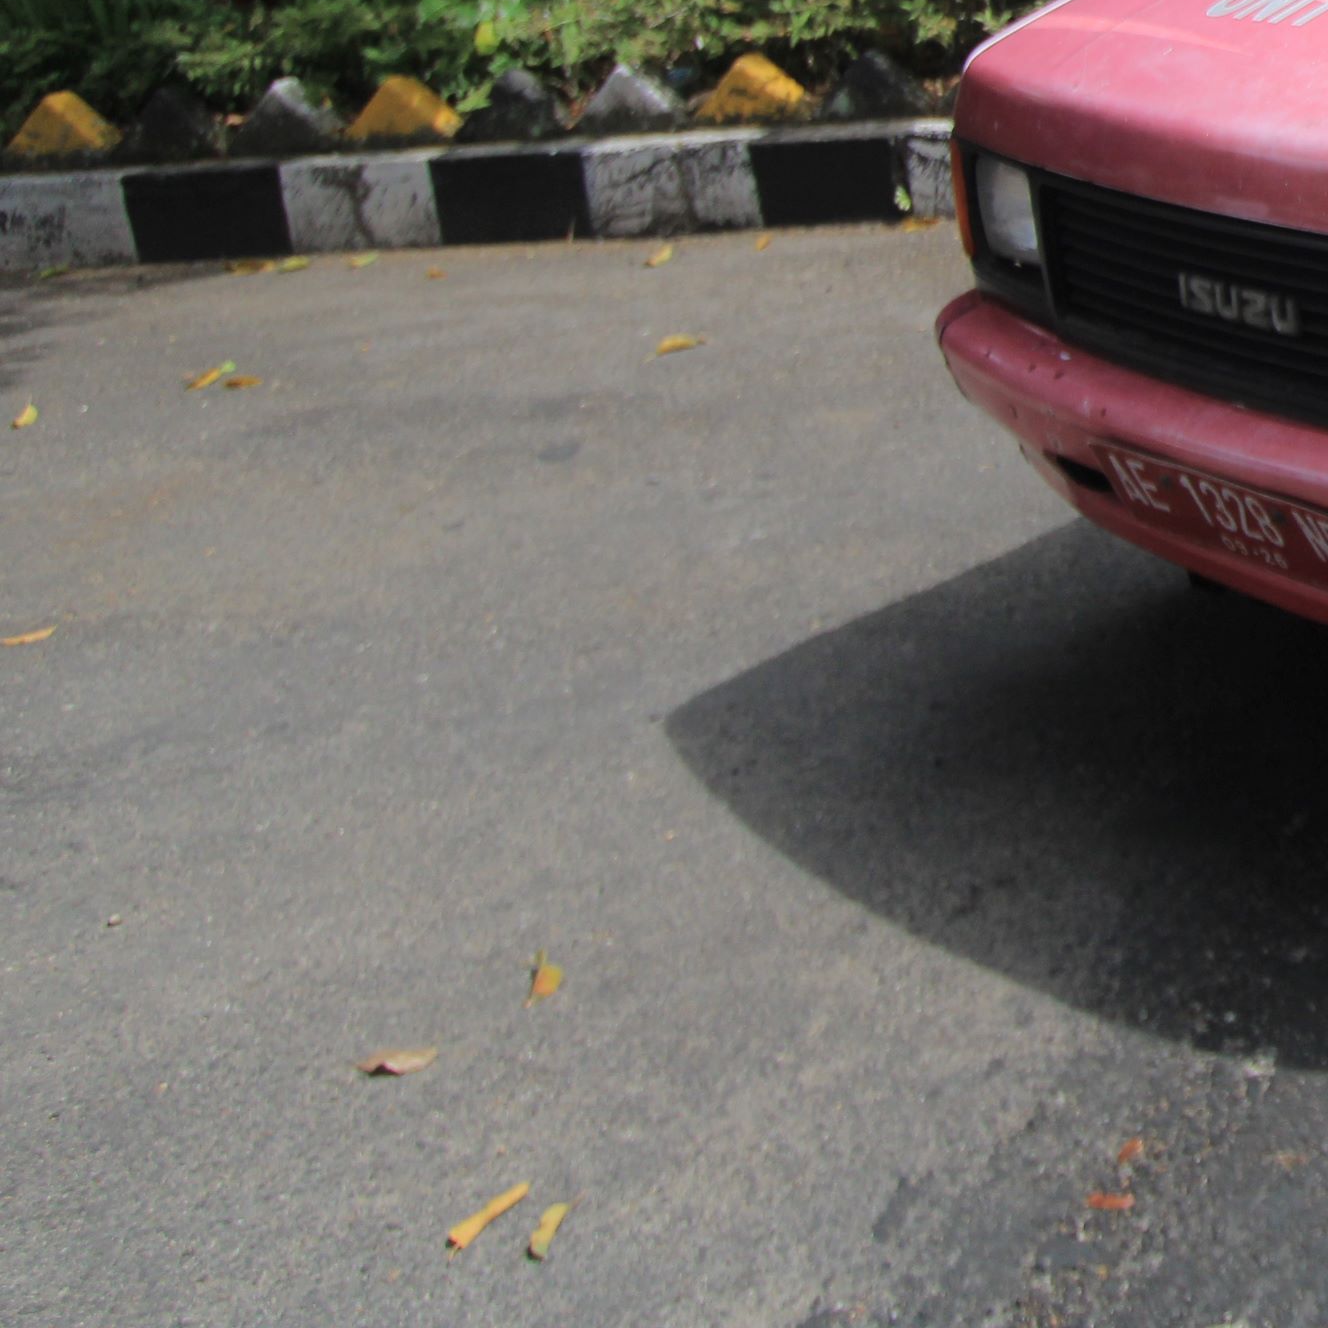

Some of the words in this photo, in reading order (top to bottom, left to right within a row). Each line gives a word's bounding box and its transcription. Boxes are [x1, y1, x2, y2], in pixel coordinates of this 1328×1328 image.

[1179, 273, 1295, 334] ISUZU
[1108, 454, 1171, 513] AE
[1179, 474, 1286, 549] 1328
